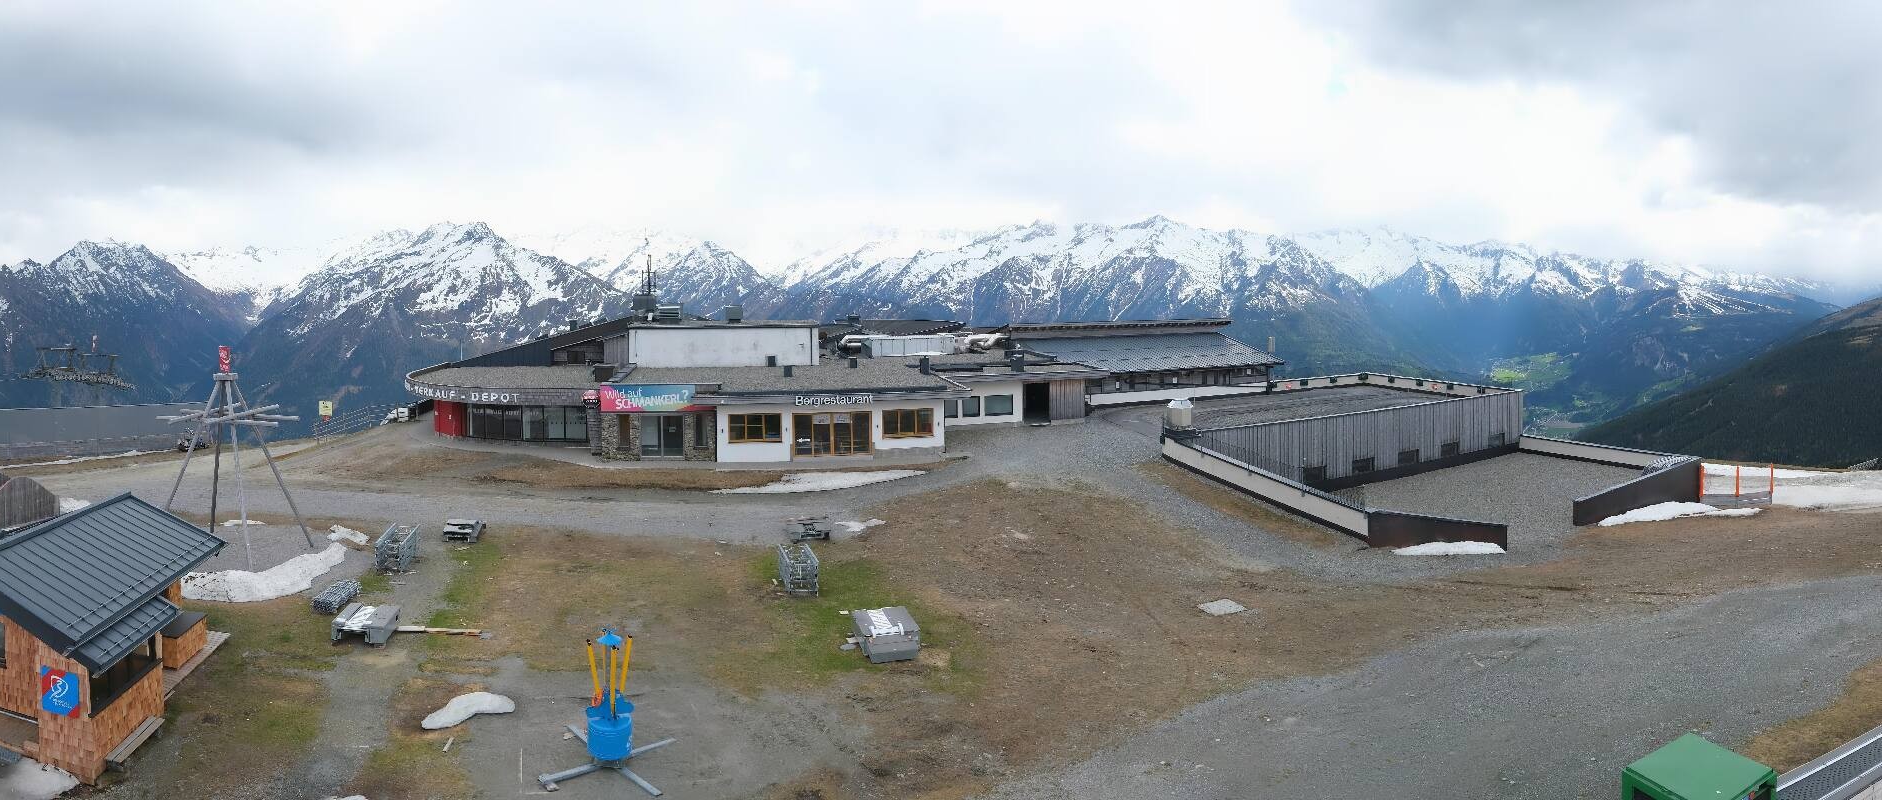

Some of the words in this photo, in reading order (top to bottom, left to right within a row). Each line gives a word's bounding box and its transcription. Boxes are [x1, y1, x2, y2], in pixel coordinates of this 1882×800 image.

[471, 392, 520, 403] DEPOT
[605, 388, 625, 400] Wild
[627, 387, 642, 398] auf
[615, 389, 689, 410] SCHMANKERL?
[795, 394, 874, 407] Bergrestaurant
